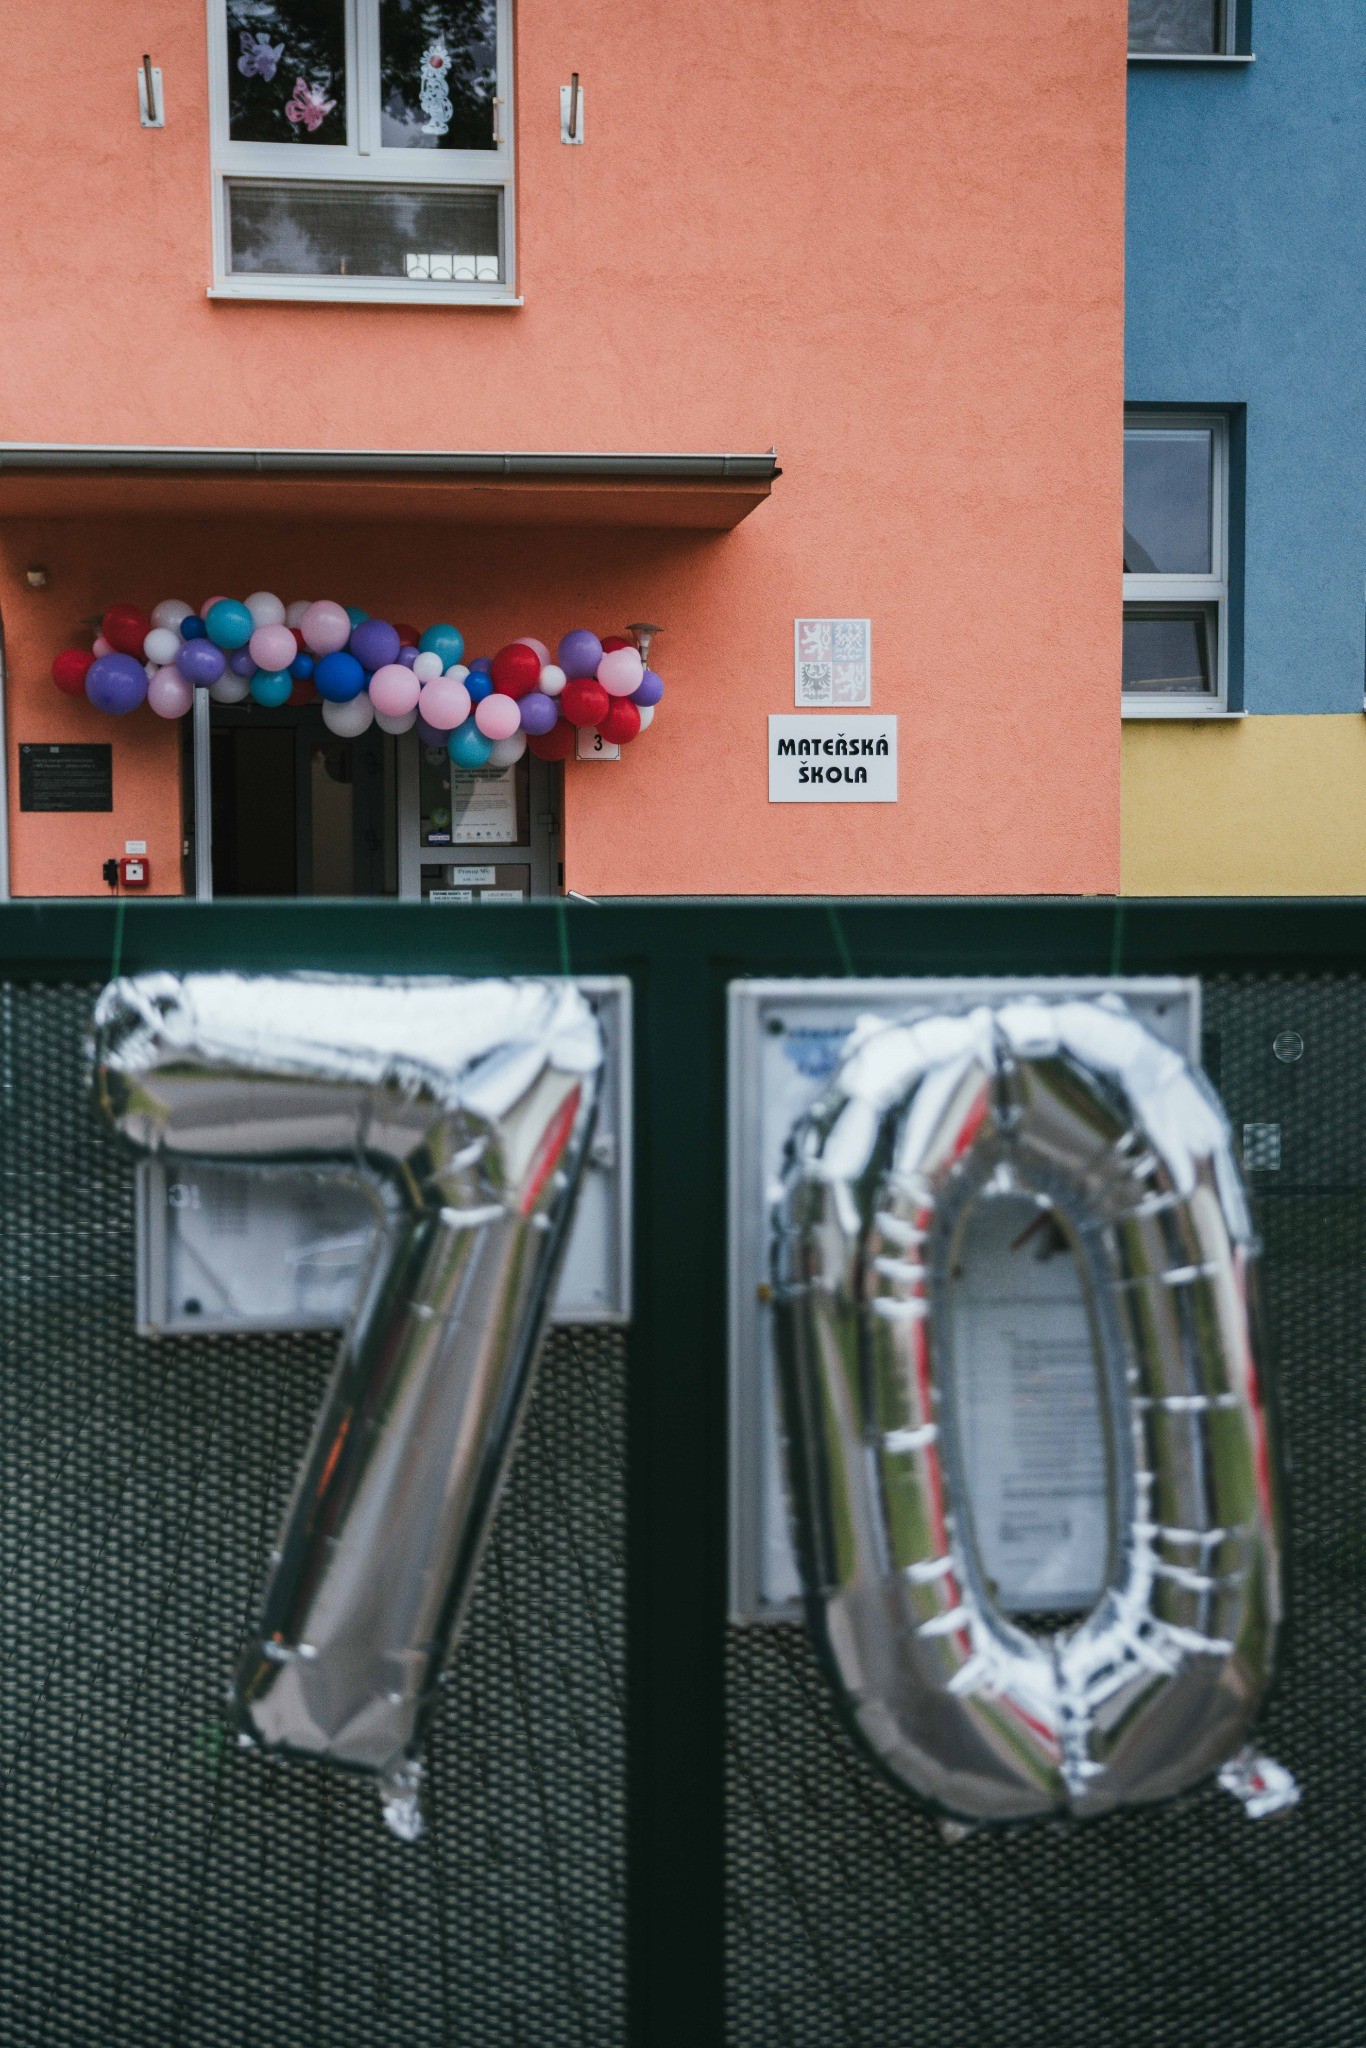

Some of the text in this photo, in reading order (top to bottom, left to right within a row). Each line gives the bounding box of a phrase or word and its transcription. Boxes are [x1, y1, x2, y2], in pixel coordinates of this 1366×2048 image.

[593, 733, 603, 752] 3
[777, 733, 889, 756] MATEŘSKÁ
[798, 760, 868, 784] ŠKOLA
